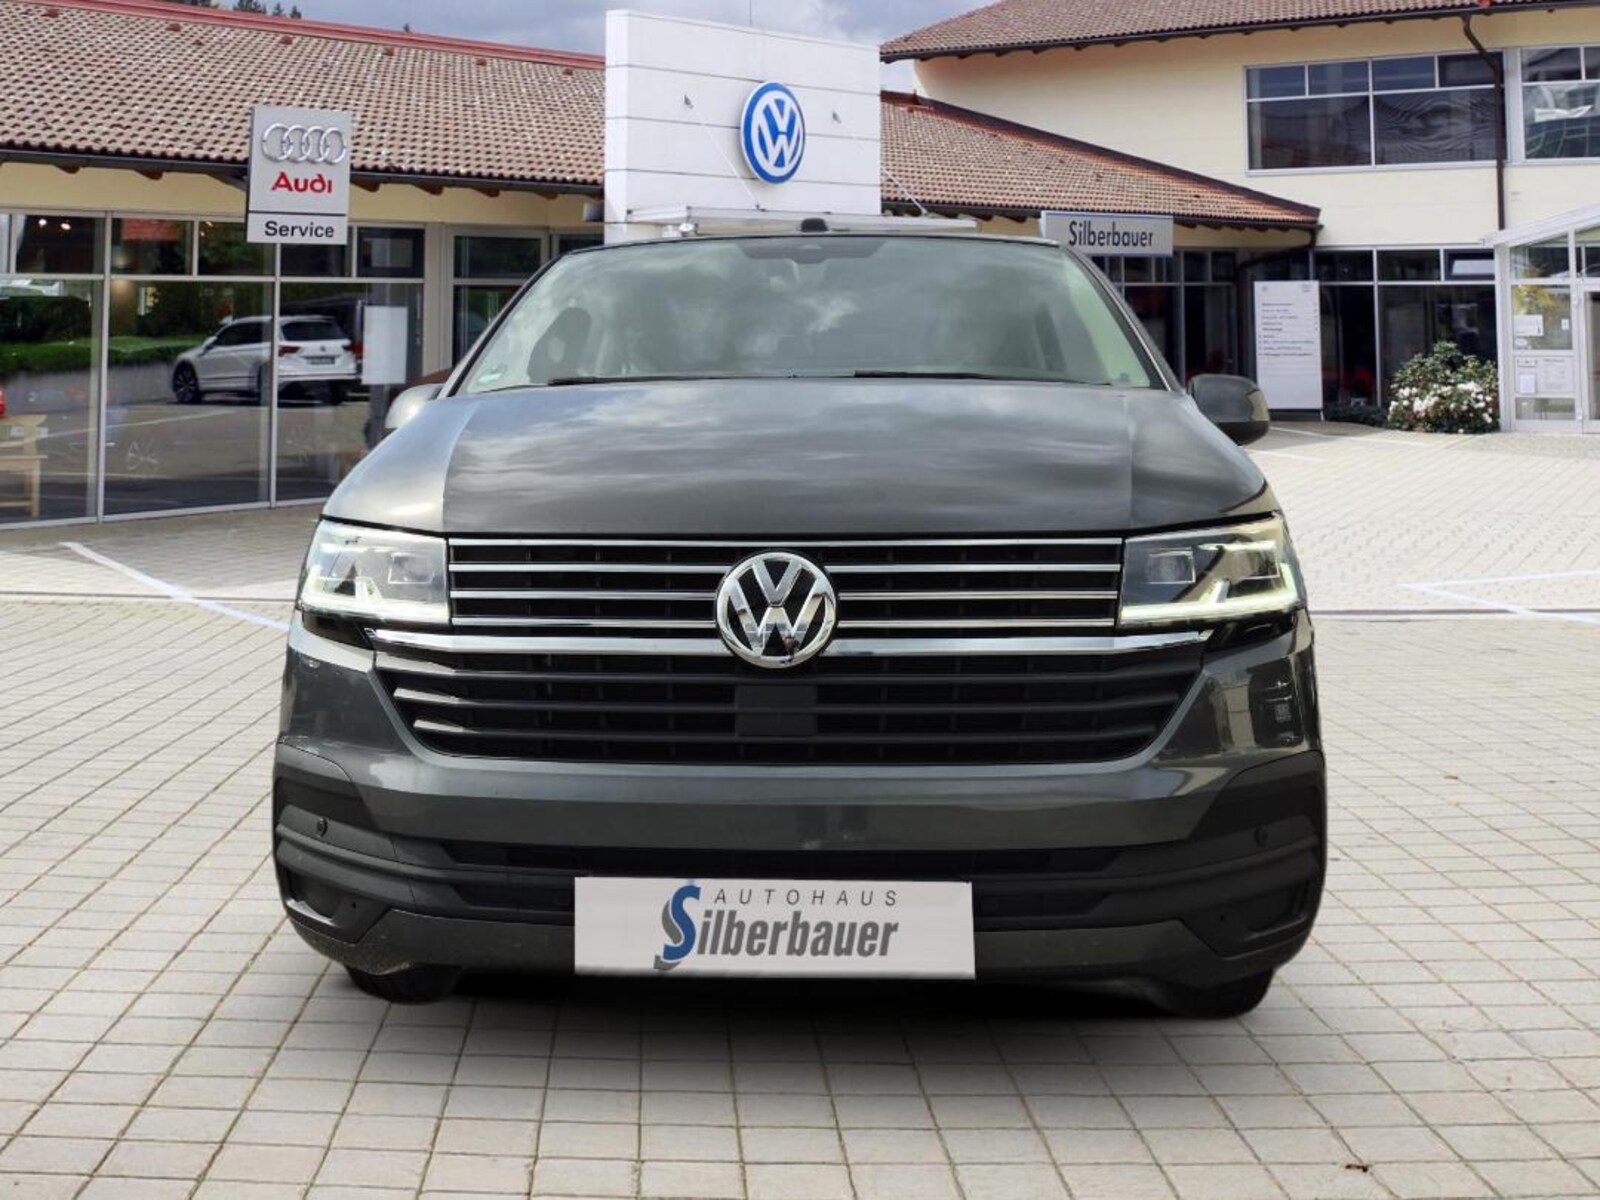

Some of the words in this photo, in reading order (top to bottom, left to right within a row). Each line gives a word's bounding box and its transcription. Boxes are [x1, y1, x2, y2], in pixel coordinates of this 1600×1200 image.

[271, 171, 332, 194] Audi
[264, 220, 334, 238] Service
[1069, 220, 1153, 247] Silberbauer
[714, 888, 898, 907] AUTOHAUS
[654, 884, 900, 971] Silberbauer
